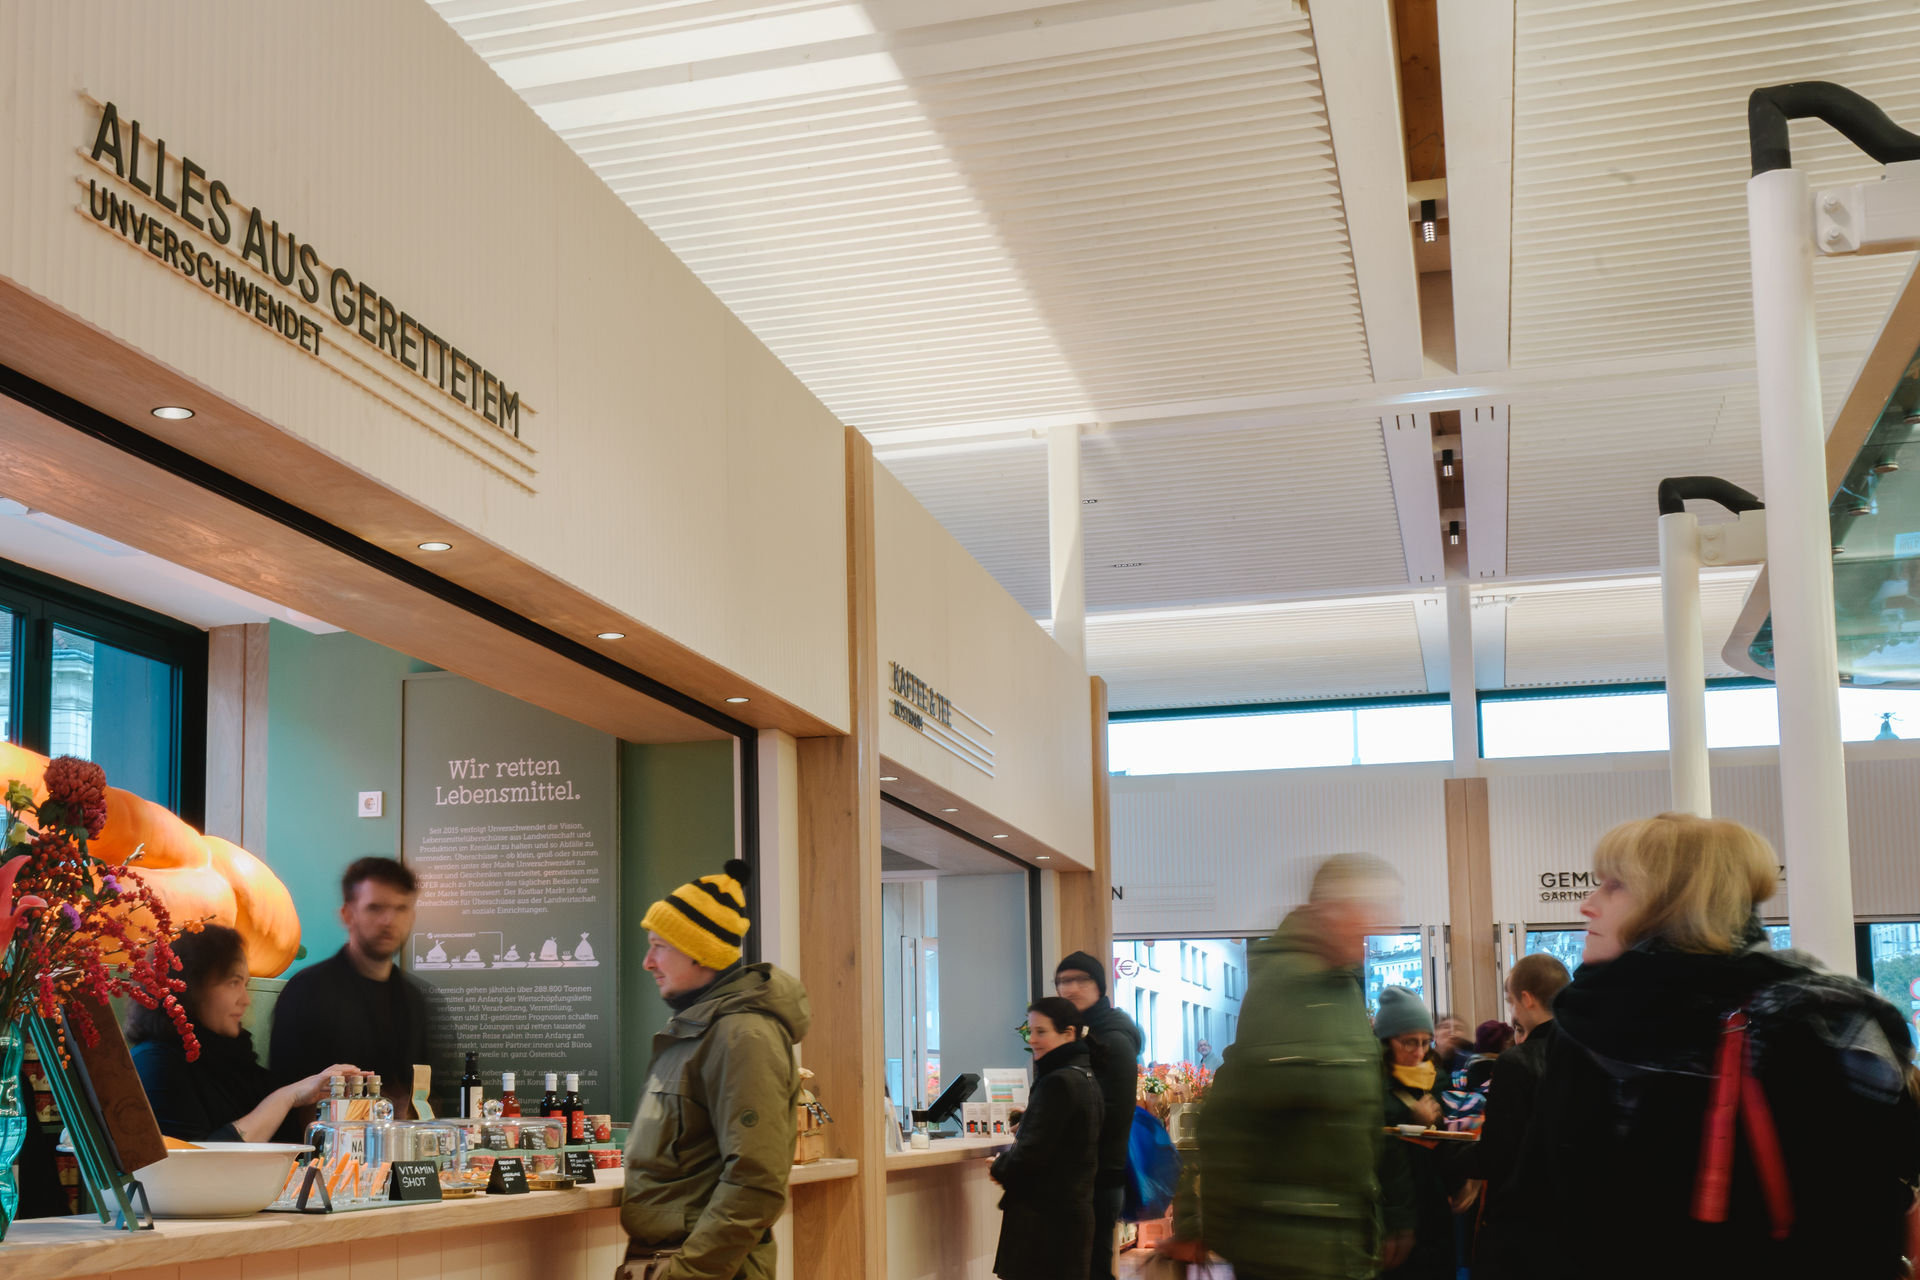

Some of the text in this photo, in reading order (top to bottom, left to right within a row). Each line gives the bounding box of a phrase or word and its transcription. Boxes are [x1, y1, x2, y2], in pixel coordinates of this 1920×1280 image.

[89, 179, 323, 356] UNVERSCHWENDET
[91, 101, 520, 439] ALLES AUS GERETTETEM
[893, 661, 928, 711] KAFFEE
[930, 688, 936, 716] &
[937, 692, 952, 727] TEE
[449, 757, 561, 779] Wir retten
[435, 780, 581, 806] Lebensmittel.
[487, 823, 546, 833] Unverschwendet
[523, 832, 575, 841] Landwirtschaft
[577, 831, 592, 839] und
[420, 845, 457, 853] Produktion
[511, 841, 533, 849] halten
[534, 841, 549, 849] und
[554, 849, 571, 858] oder
[572, 848, 599, 857] krumm
[493, 860, 515, 869] Marke
[516, 858, 575, 868] Unverschwendet
[543, 868, 585, 878] gemeinsam
[586, 867, 599, 875] mit
[468, 879, 504, 888] Produkten
[580, 876, 600, 885] unter
[437, 889, 459, 898] Marke
[503, 887, 516, 896] Der
[545, 886, 566, 895] Markt
[472, 896, 515, 906] Überschüsse
[530, 896, 543, 904] der
[543, 894, 597, 904] Landwirtschaft
[465, 986, 488, 995] gehen
[488, 985, 515, 994] jährlich
[516, 985, 533, 993] über
[563, 984, 592, 993] Tonnen
[477, 995, 503, 1005] Anfang
[504, 995, 516, 1003] der
[517, 994, 592, 1004] Wertschöpfungskette
[468, 1004, 480, 1012] Mit
[464, 1013, 479, 1021] und
[528, 1013, 567, 1022] Prognosen
[567, 1012, 599, 1021] schaffen
[479, 1023, 514, 1032] Lösungen
[553, 1022, 587, 1030] tausende
[456, 1032, 481, 1040] Unsere
[524, 1031, 544, 1039] ihren
[545, 1031, 571, 1041] Anfang
[555, 1040, 569, 1049] und
[571, 1040, 593, 1049] Büros
[510, 1051, 528, 1059] ganz
[528, 1049, 568, 1058] Österreich.
[398, 1165, 435, 1176] VITAMIN
[402, 1176, 427, 1188] SHOT
